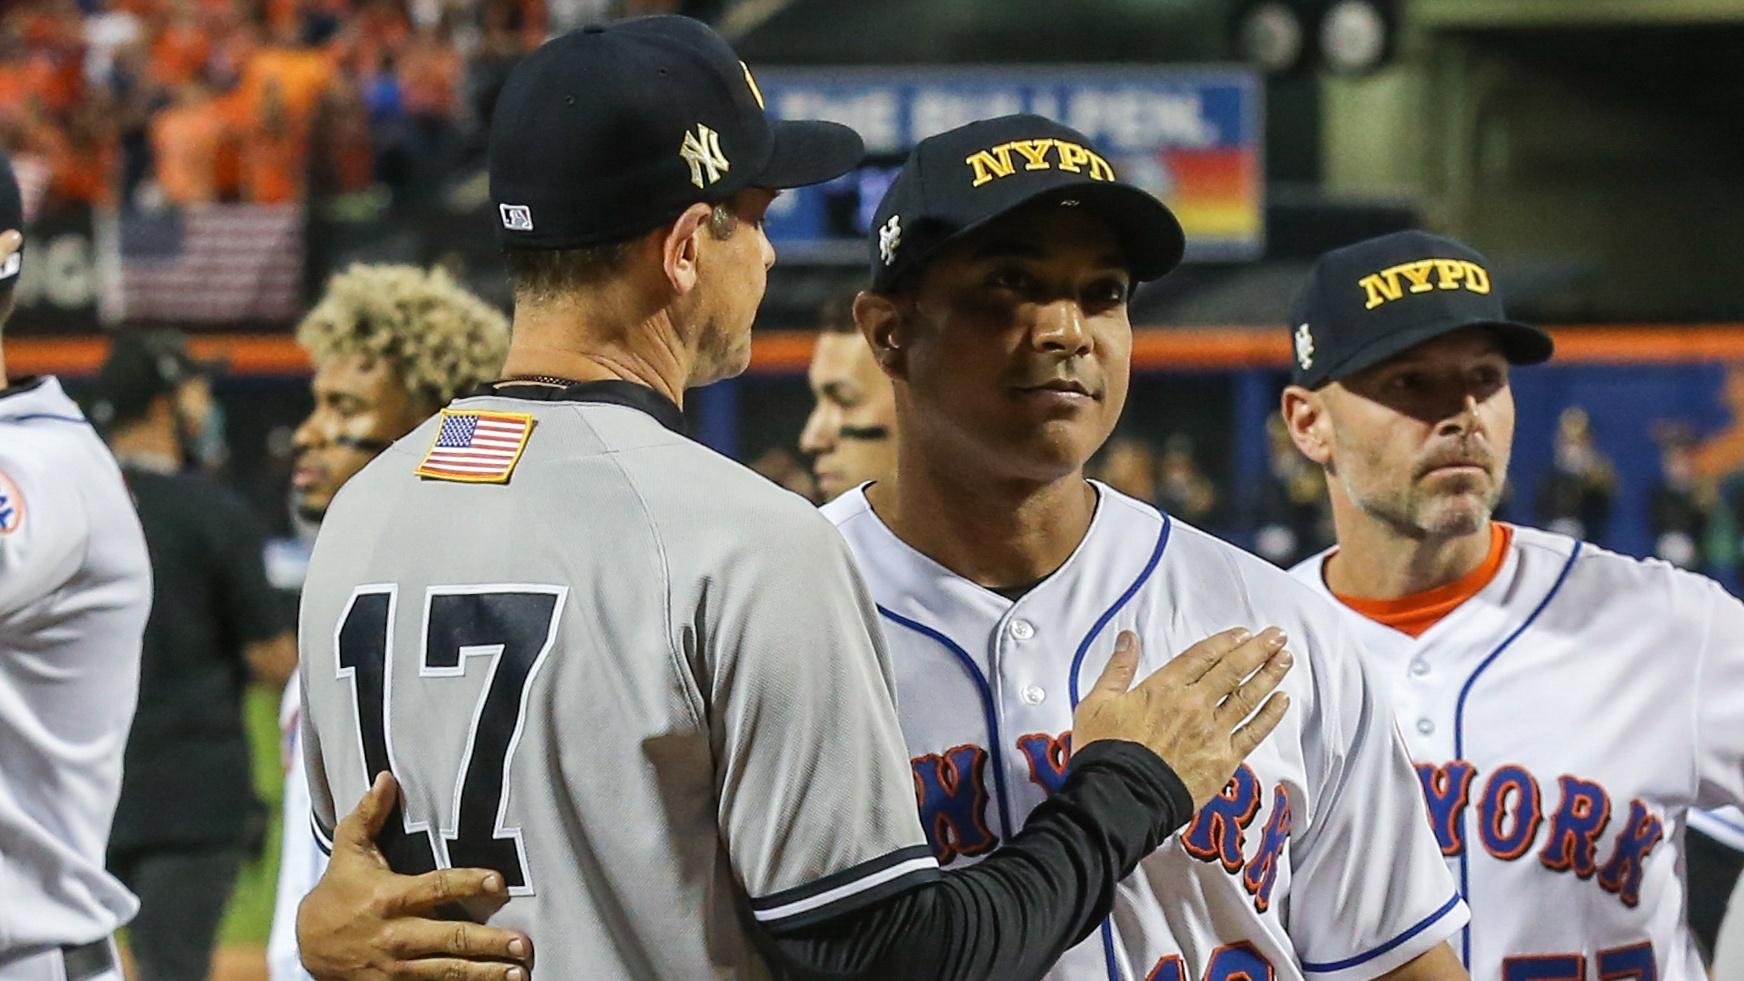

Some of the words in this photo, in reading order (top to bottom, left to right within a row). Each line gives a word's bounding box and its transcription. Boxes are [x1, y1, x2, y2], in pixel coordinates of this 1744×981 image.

[679, 122, 731, 189] NY
[965, 138, 1116, 188] NYPD
[1358, 258, 1491, 310] NYPD
[335, 582, 571, 898] 17
[1414, 760, 1664, 909] YORK
